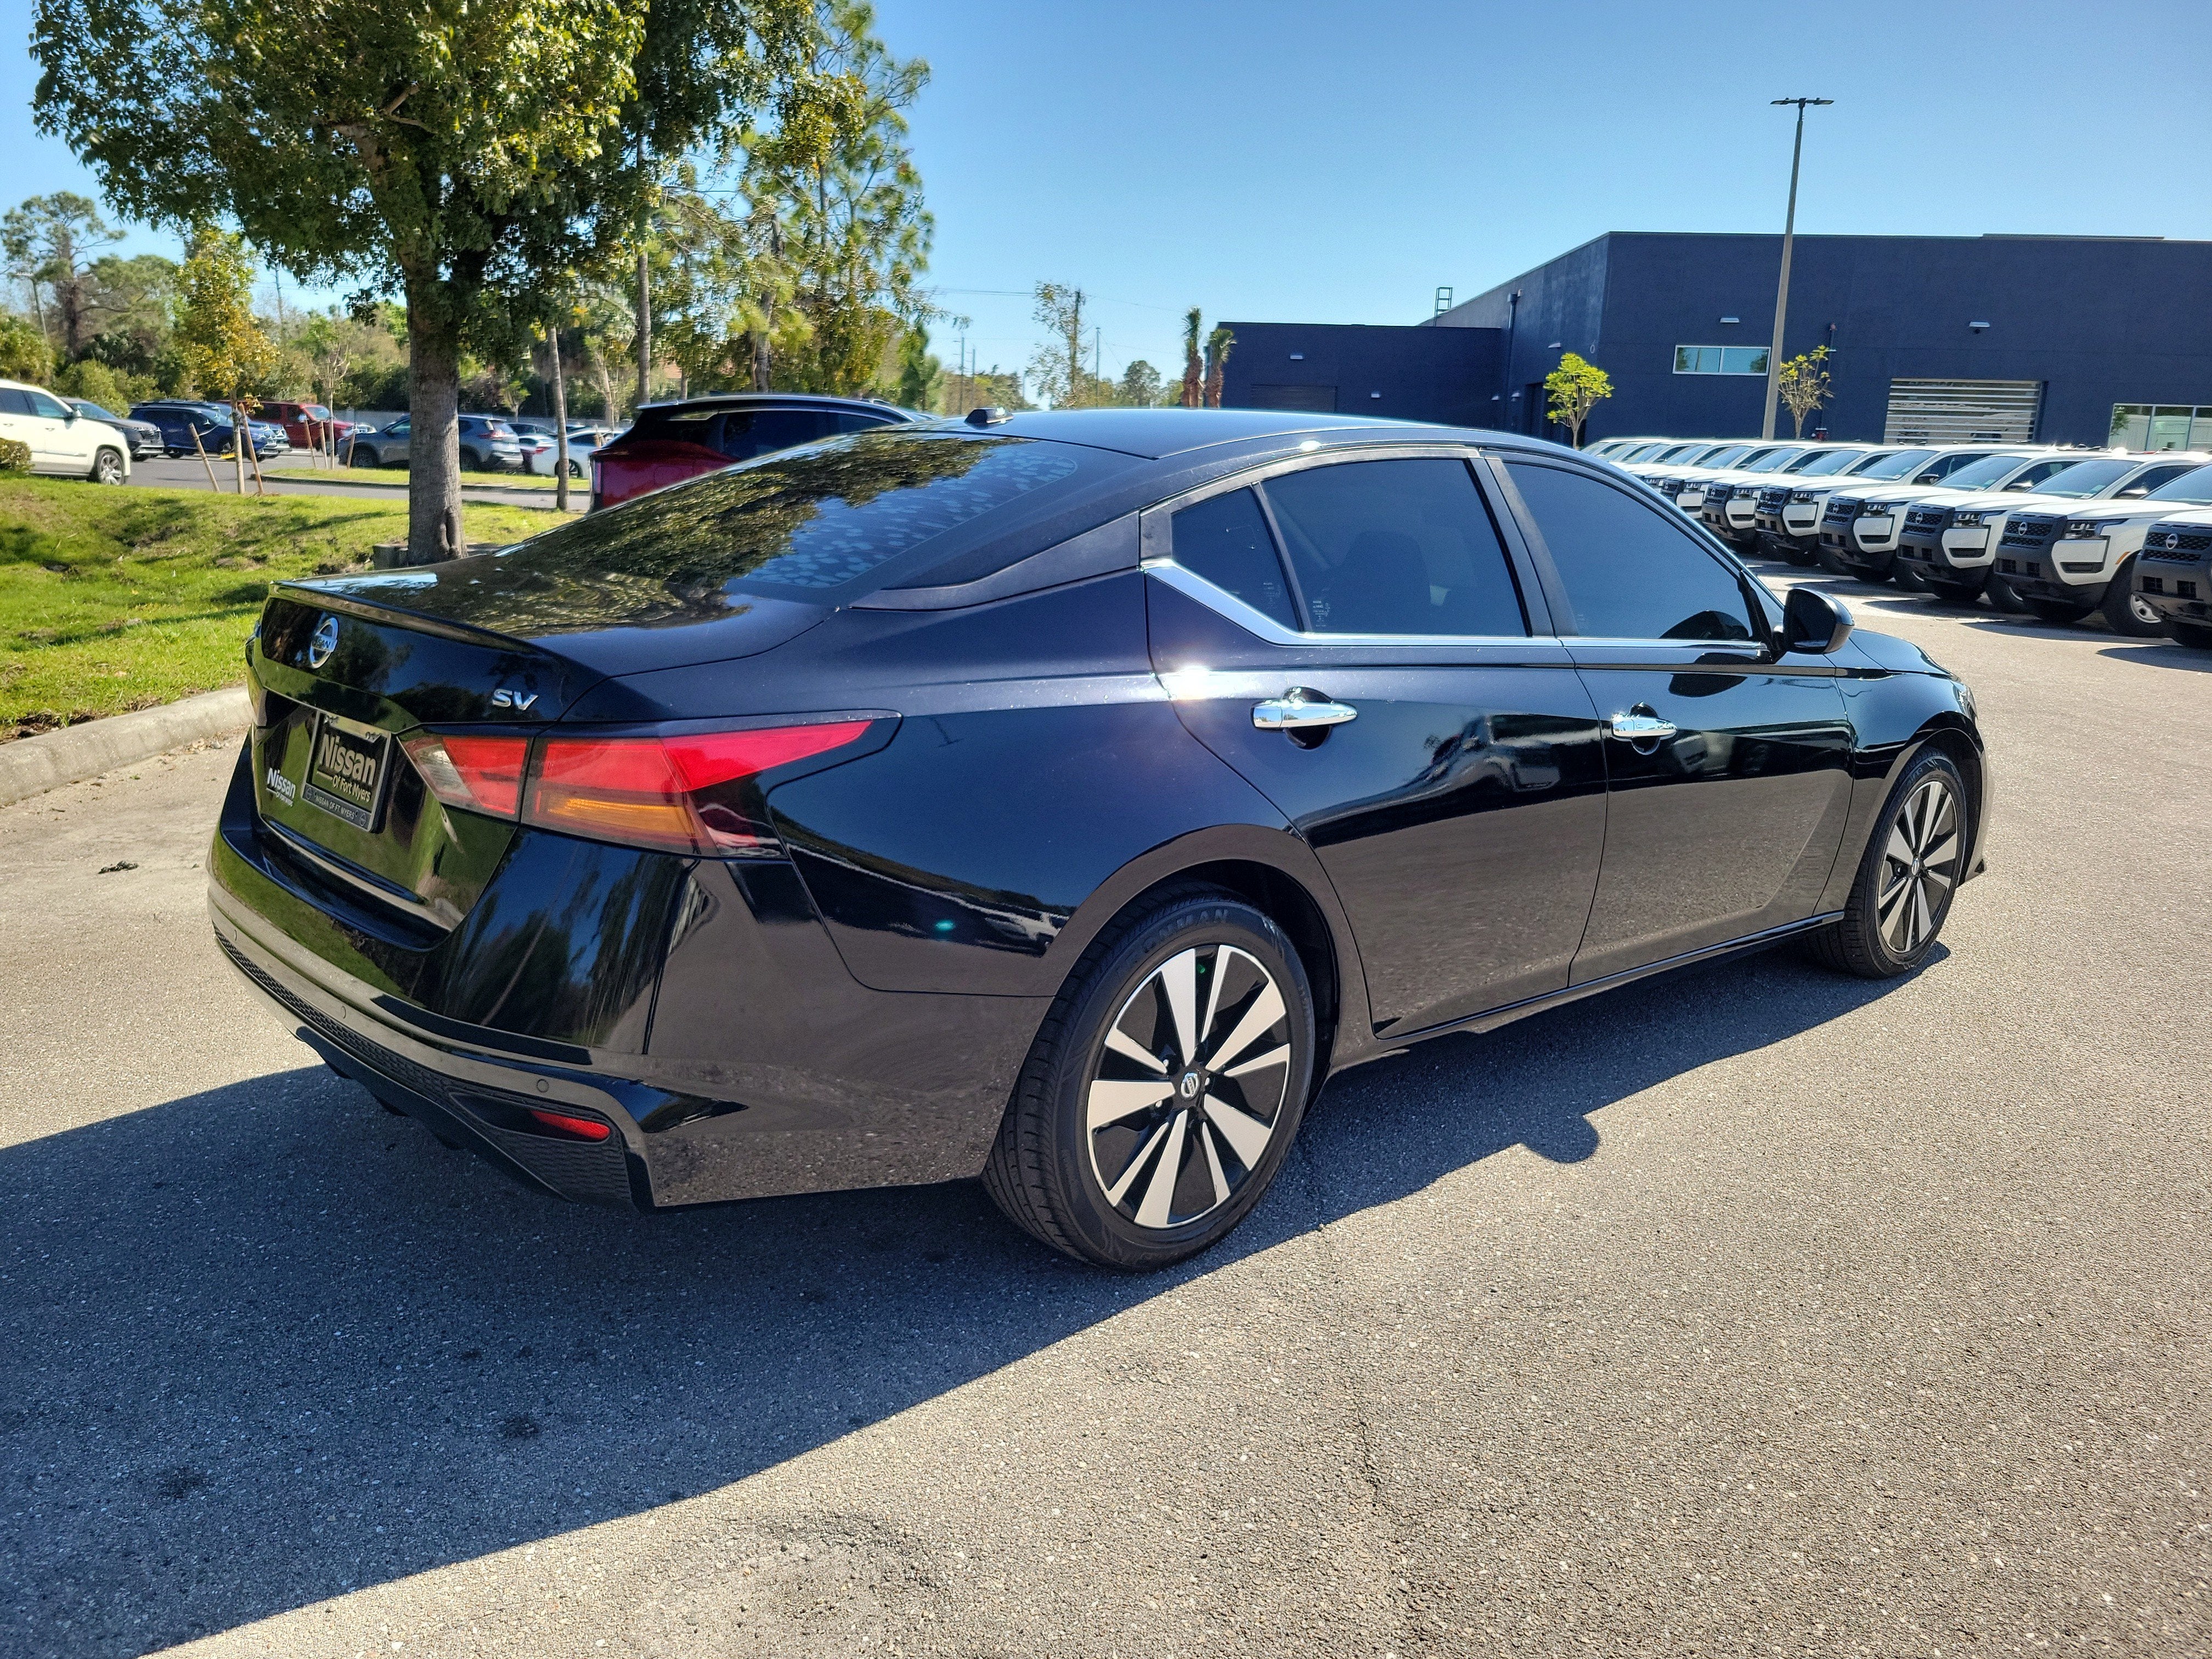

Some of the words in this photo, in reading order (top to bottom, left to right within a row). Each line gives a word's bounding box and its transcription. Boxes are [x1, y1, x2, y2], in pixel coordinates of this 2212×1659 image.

[492, 689, 539, 710] SV
[319, 733, 376, 786] Nissan
[267, 767, 296, 799] Nissan
[332, 775, 340, 789] Of
[340, 778, 353, 795] Fort
[352, 783, 371, 803] Myers
[315, 795, 330, 809] NISSAN
[329, 802, 336, 810] OF
[340, 807, 354, 820] MYERS
